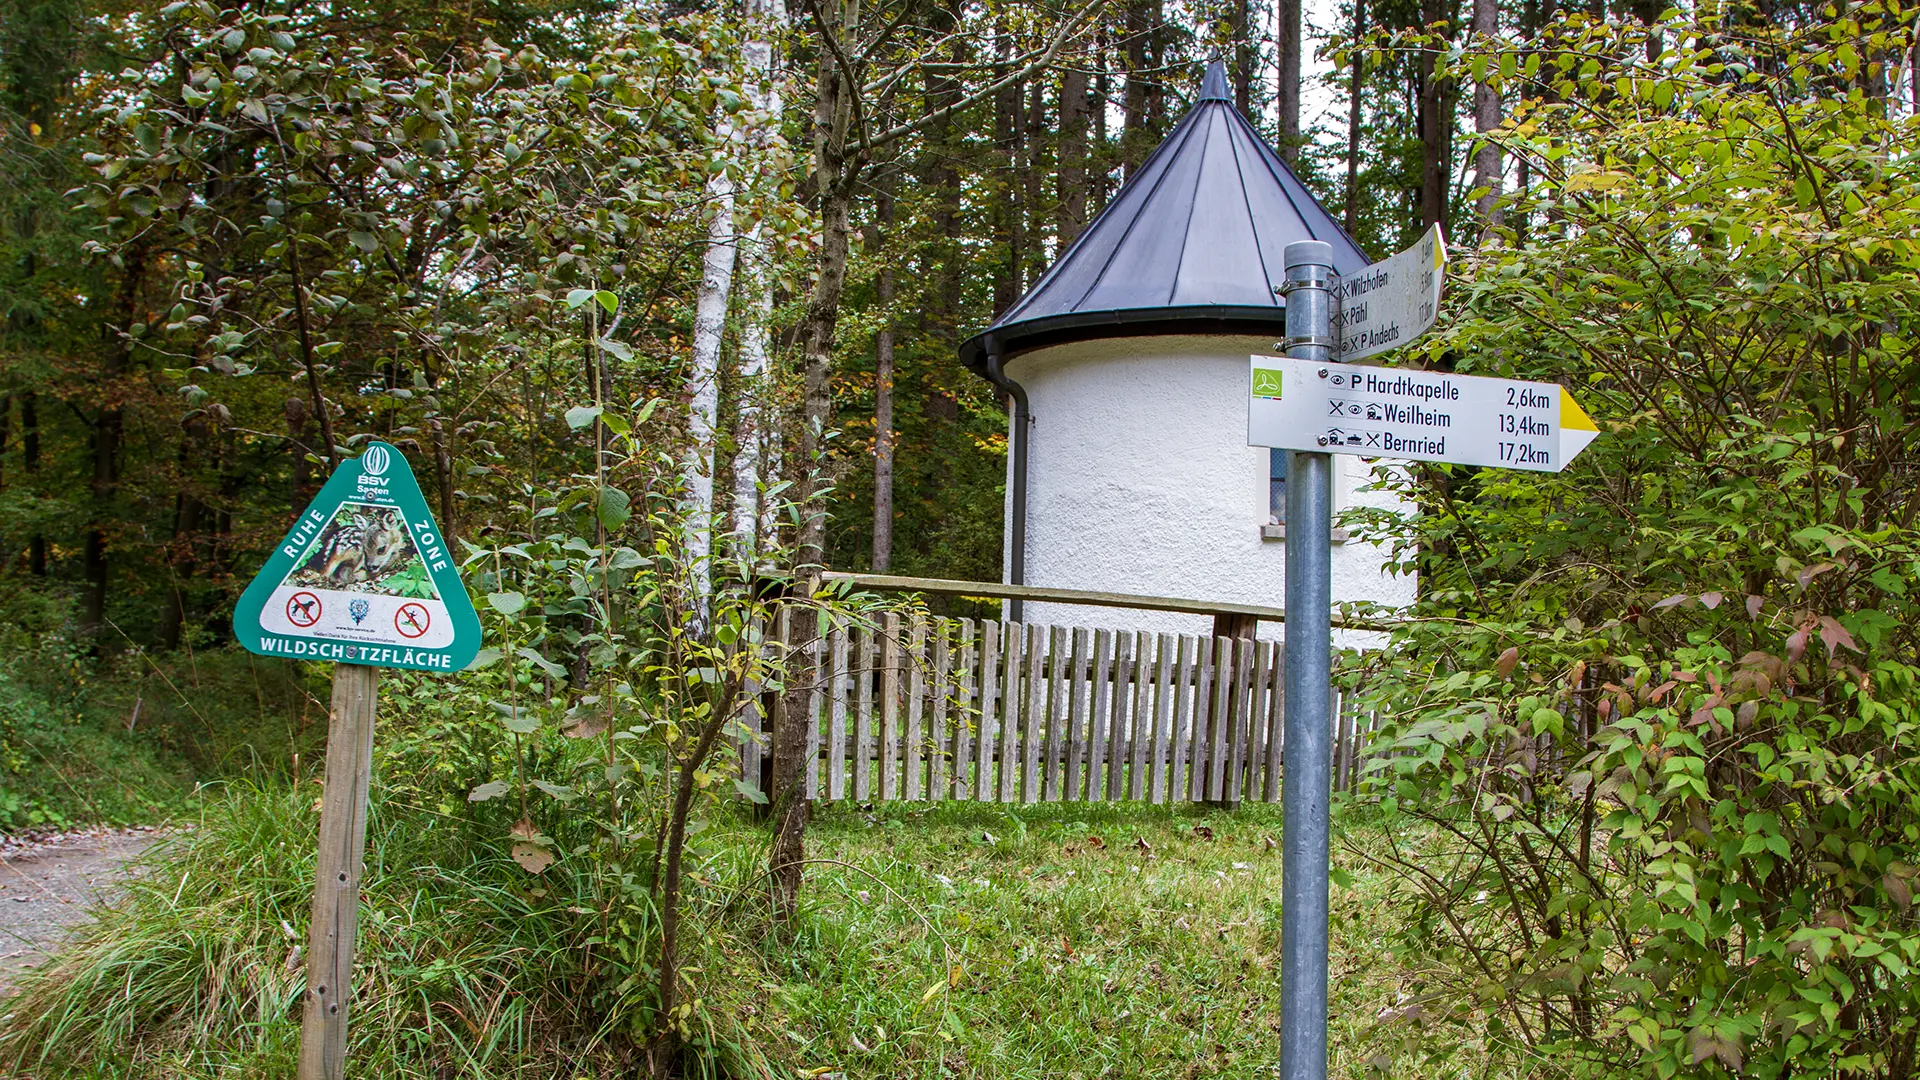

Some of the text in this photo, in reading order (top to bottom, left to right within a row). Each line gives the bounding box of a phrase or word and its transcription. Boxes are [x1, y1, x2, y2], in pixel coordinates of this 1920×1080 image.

[1350, 268, 1388, 298] Wilzhofen
[1350, 301, 1368, 326] Pähl
[1368, 320, 1399, 348] Andechs
[1367, 374, 1459, 402] Hardtkapelle
[1506, 387, 1550, 409] 2,6km
[1384, 403, 1549, 437] Weilheim 13,4km
[1384, 432, 1549, 465] Bernried 17,2km
[357, 475, 390, 486] BSV
[283, 509, 325, 558] RUHE
[414, 520, 447, 573] ZONE
